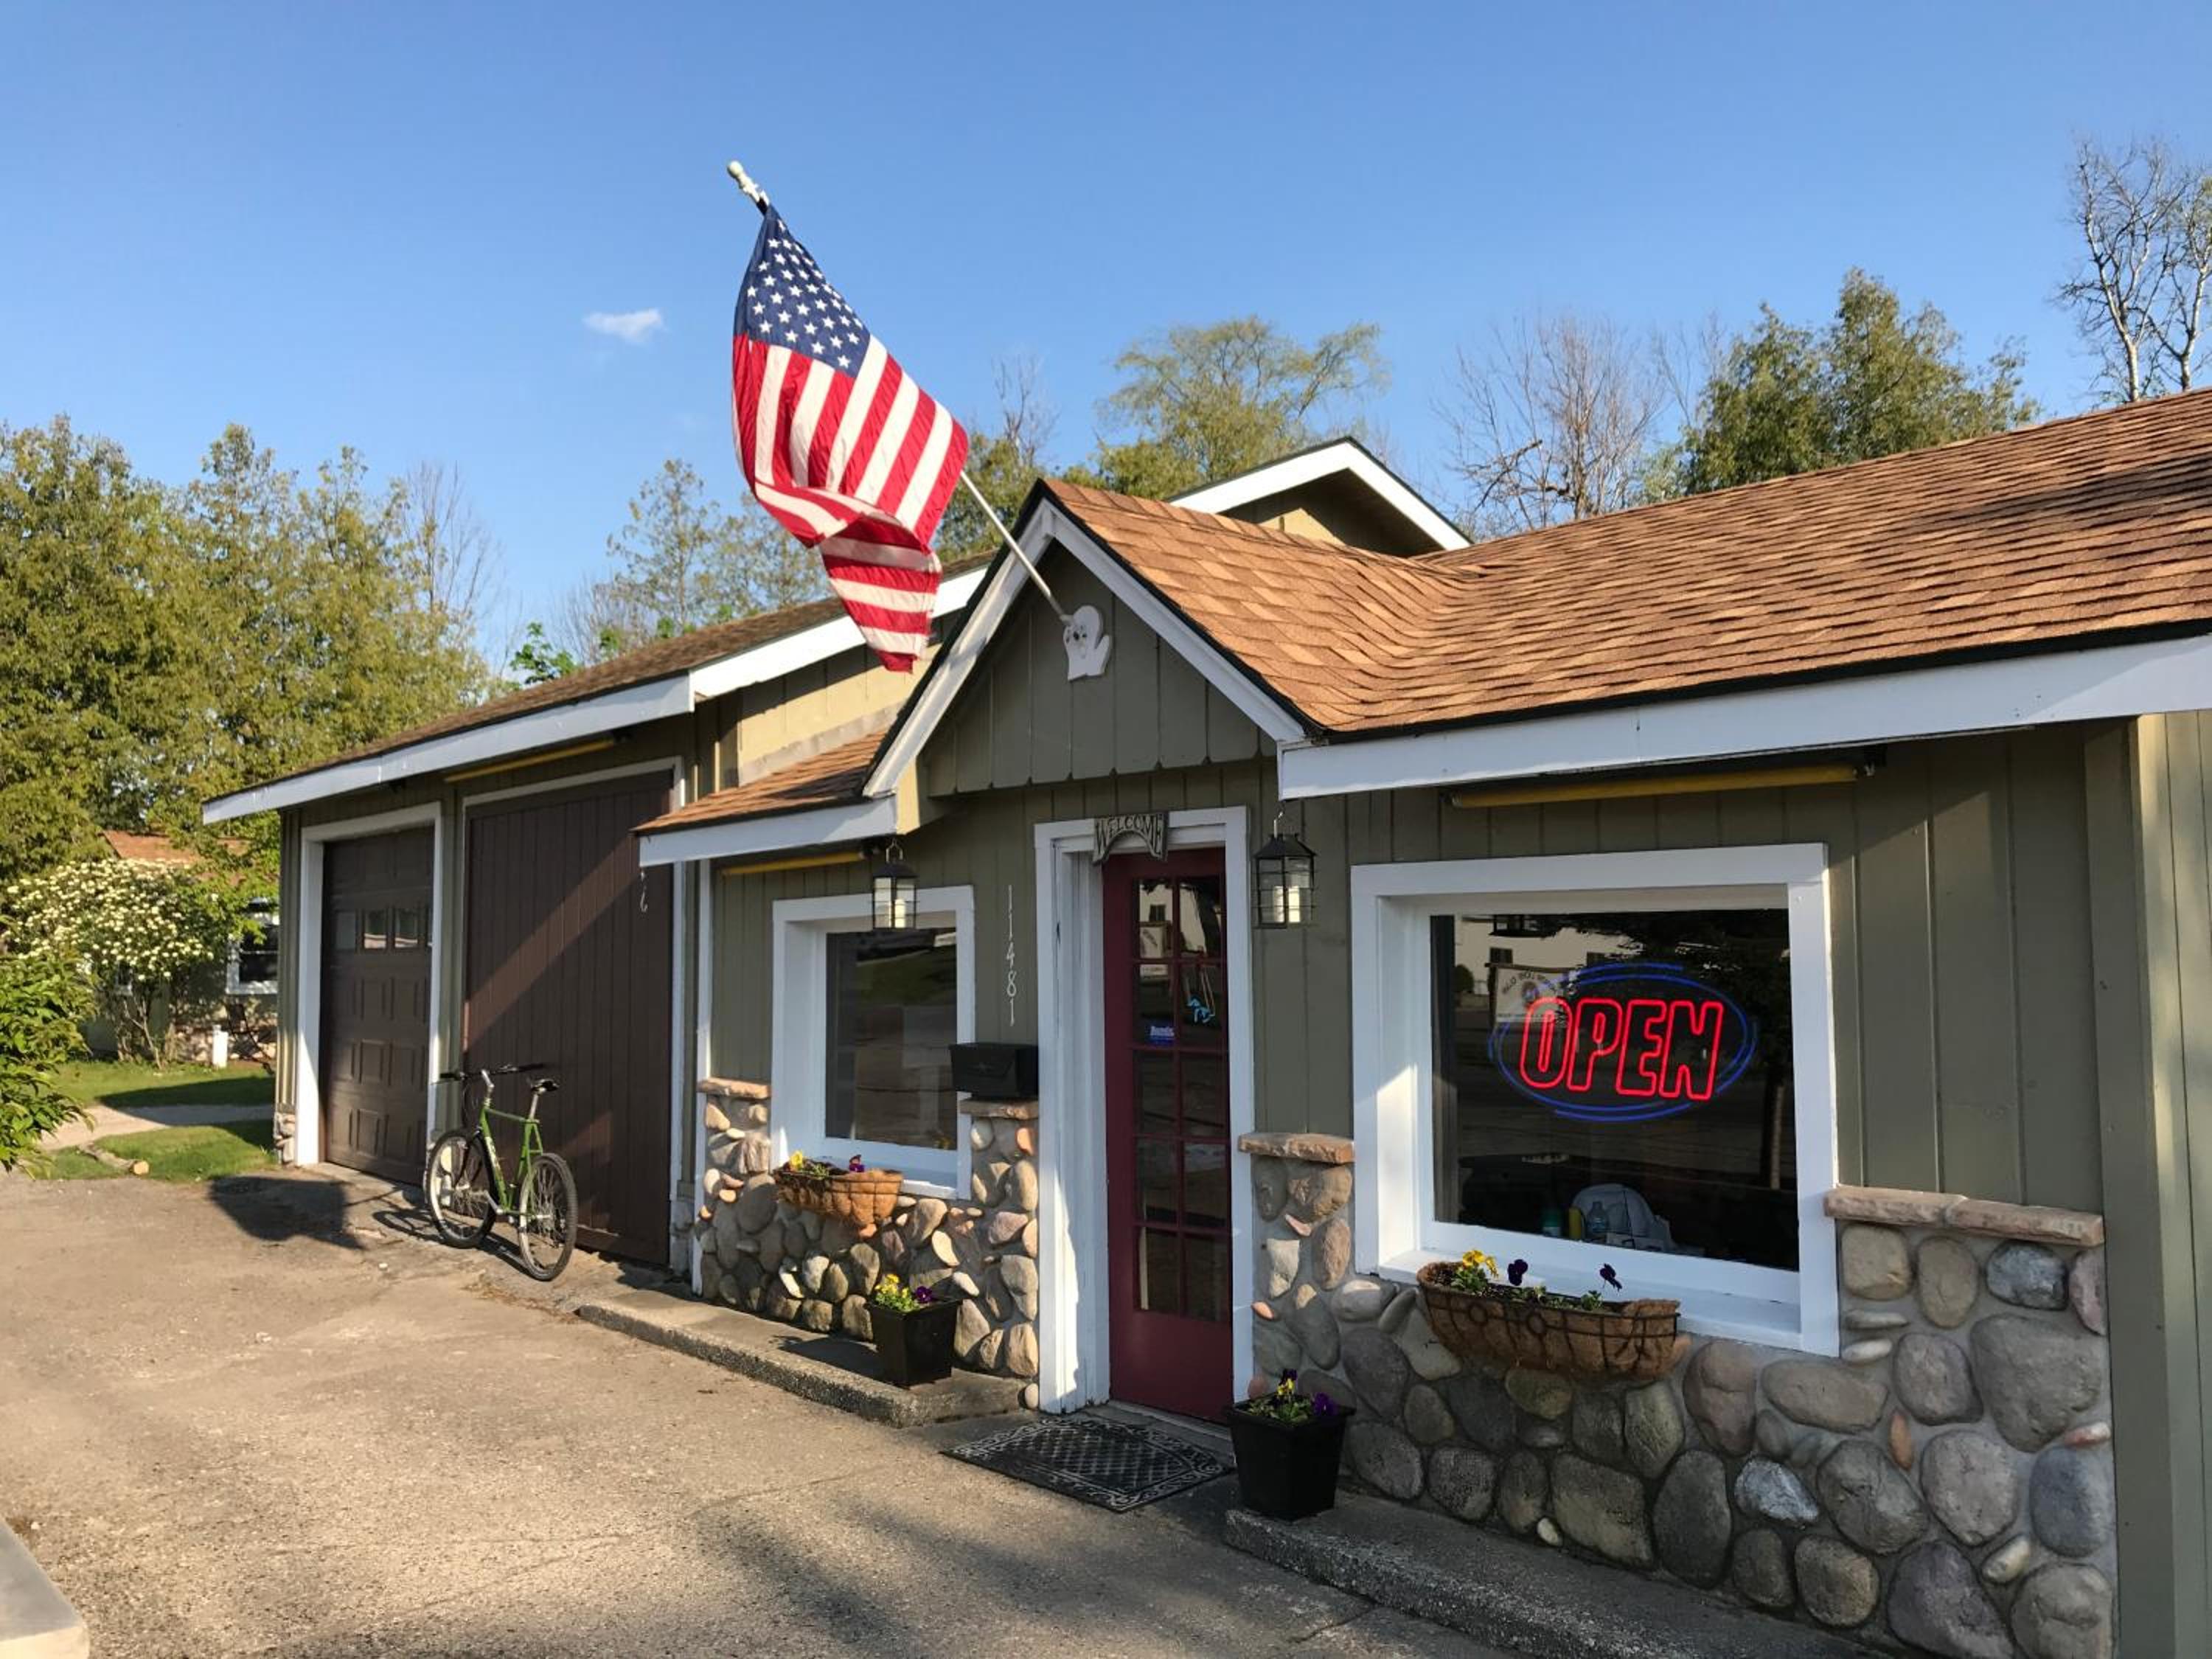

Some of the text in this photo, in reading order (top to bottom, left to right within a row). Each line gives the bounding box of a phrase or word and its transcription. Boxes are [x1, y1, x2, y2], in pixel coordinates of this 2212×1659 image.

[1096, 814, 1163, 856] WELCOME
[1006, 884, 1017, 1027] 11481
[1520, 998, 1725, 1100] OPEN
